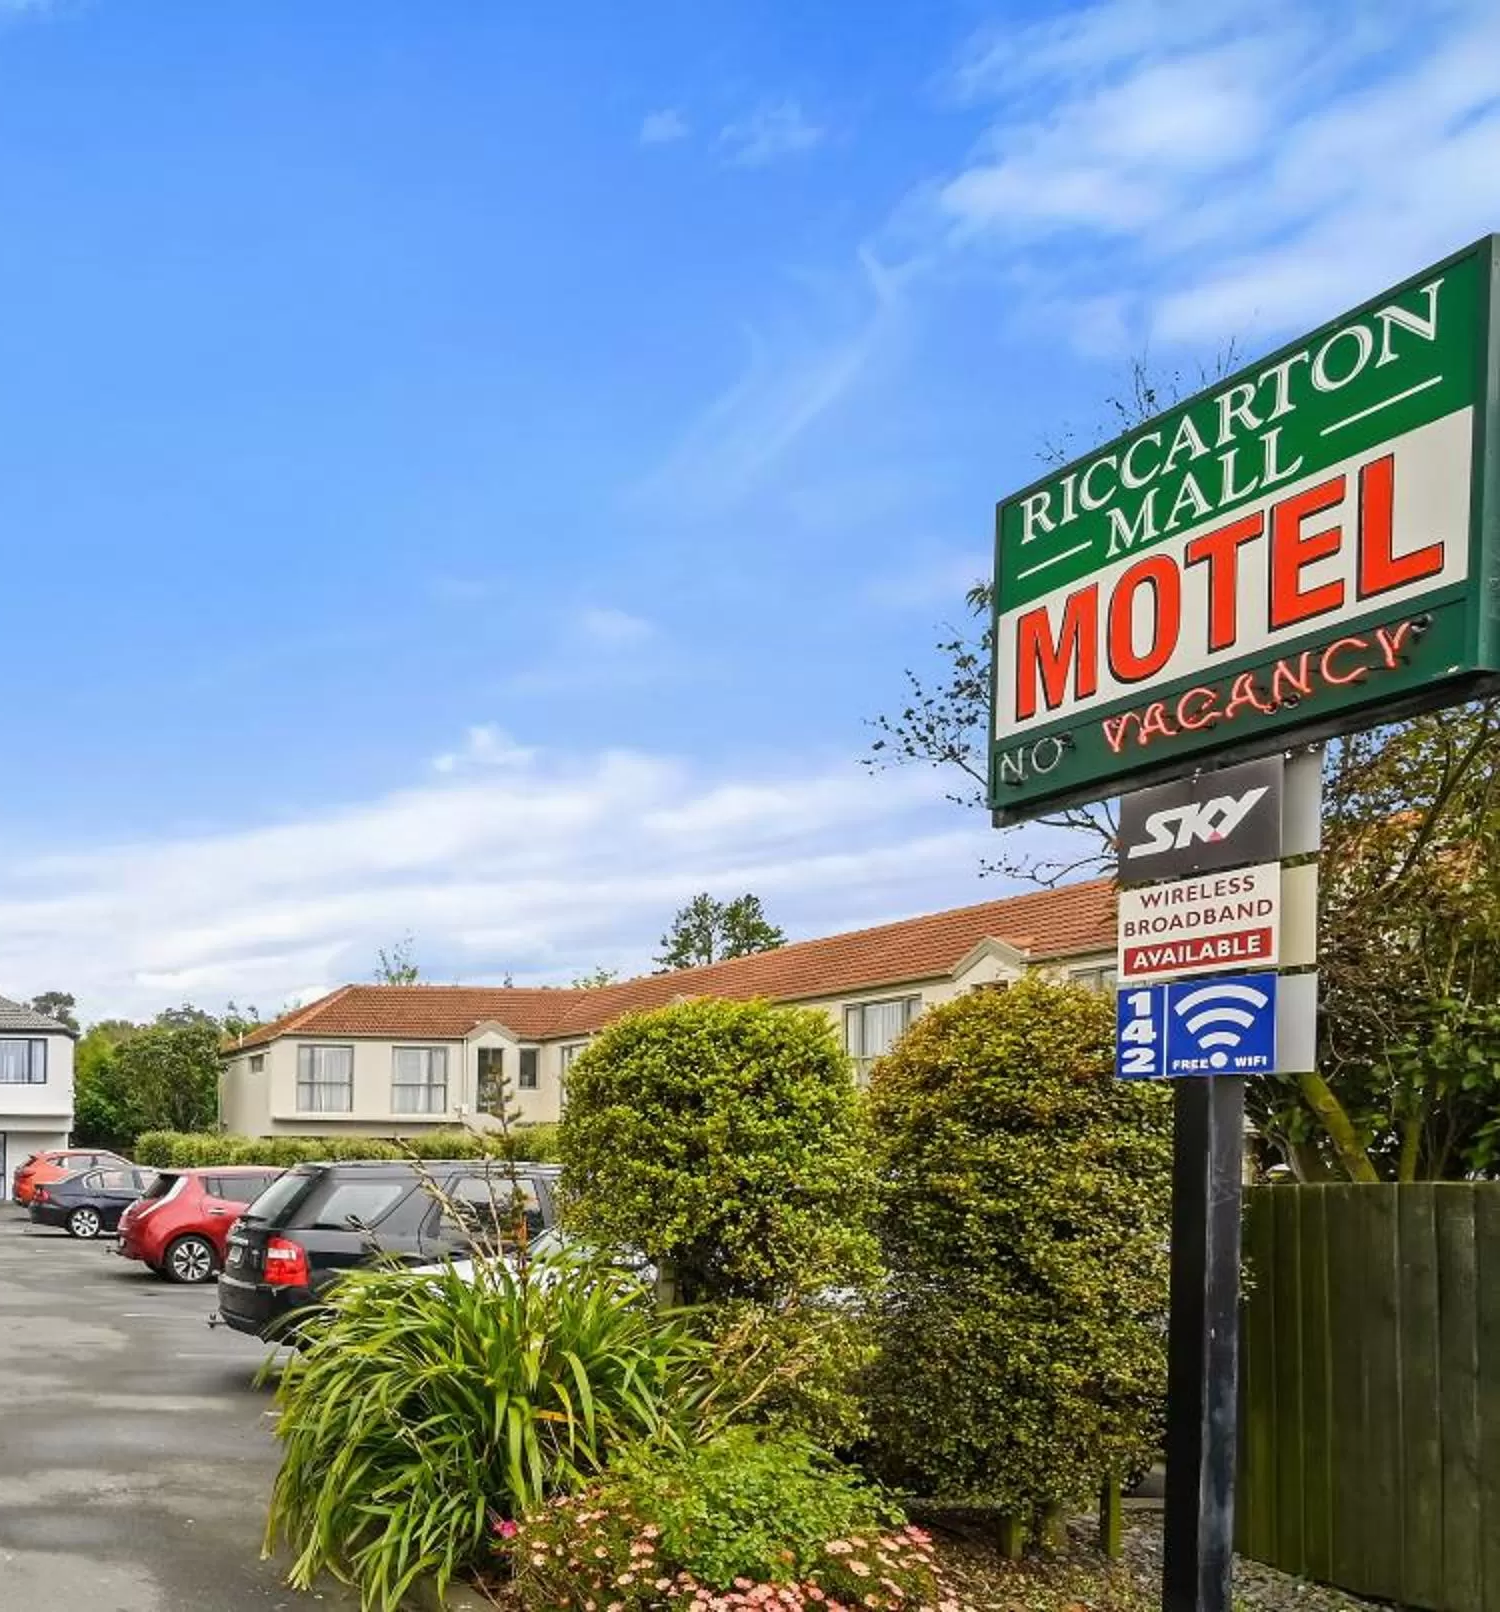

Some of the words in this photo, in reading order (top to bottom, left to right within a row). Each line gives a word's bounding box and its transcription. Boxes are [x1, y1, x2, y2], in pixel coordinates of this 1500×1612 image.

[1019, 278, 1445, 545] RICCARTON
[1105, 426, 1303, 559] MALL
[1015, 453, 1444, 723] MOTEL
[1000, 736, 1063, 782] NO
[1102, 622, 1409, 753] VACANCY
[1127, 785, 1272, 859] SKY
[1124, 899, 1273, 938] BROADBAND
[1140, 875, 1255, 909] WIRELESS
[1132, 935, 1261, 970] AVAILABLE
[1172, 1056, 1209, 1070] FREE
[1234, 1055, 1267, 1068] WIFI
